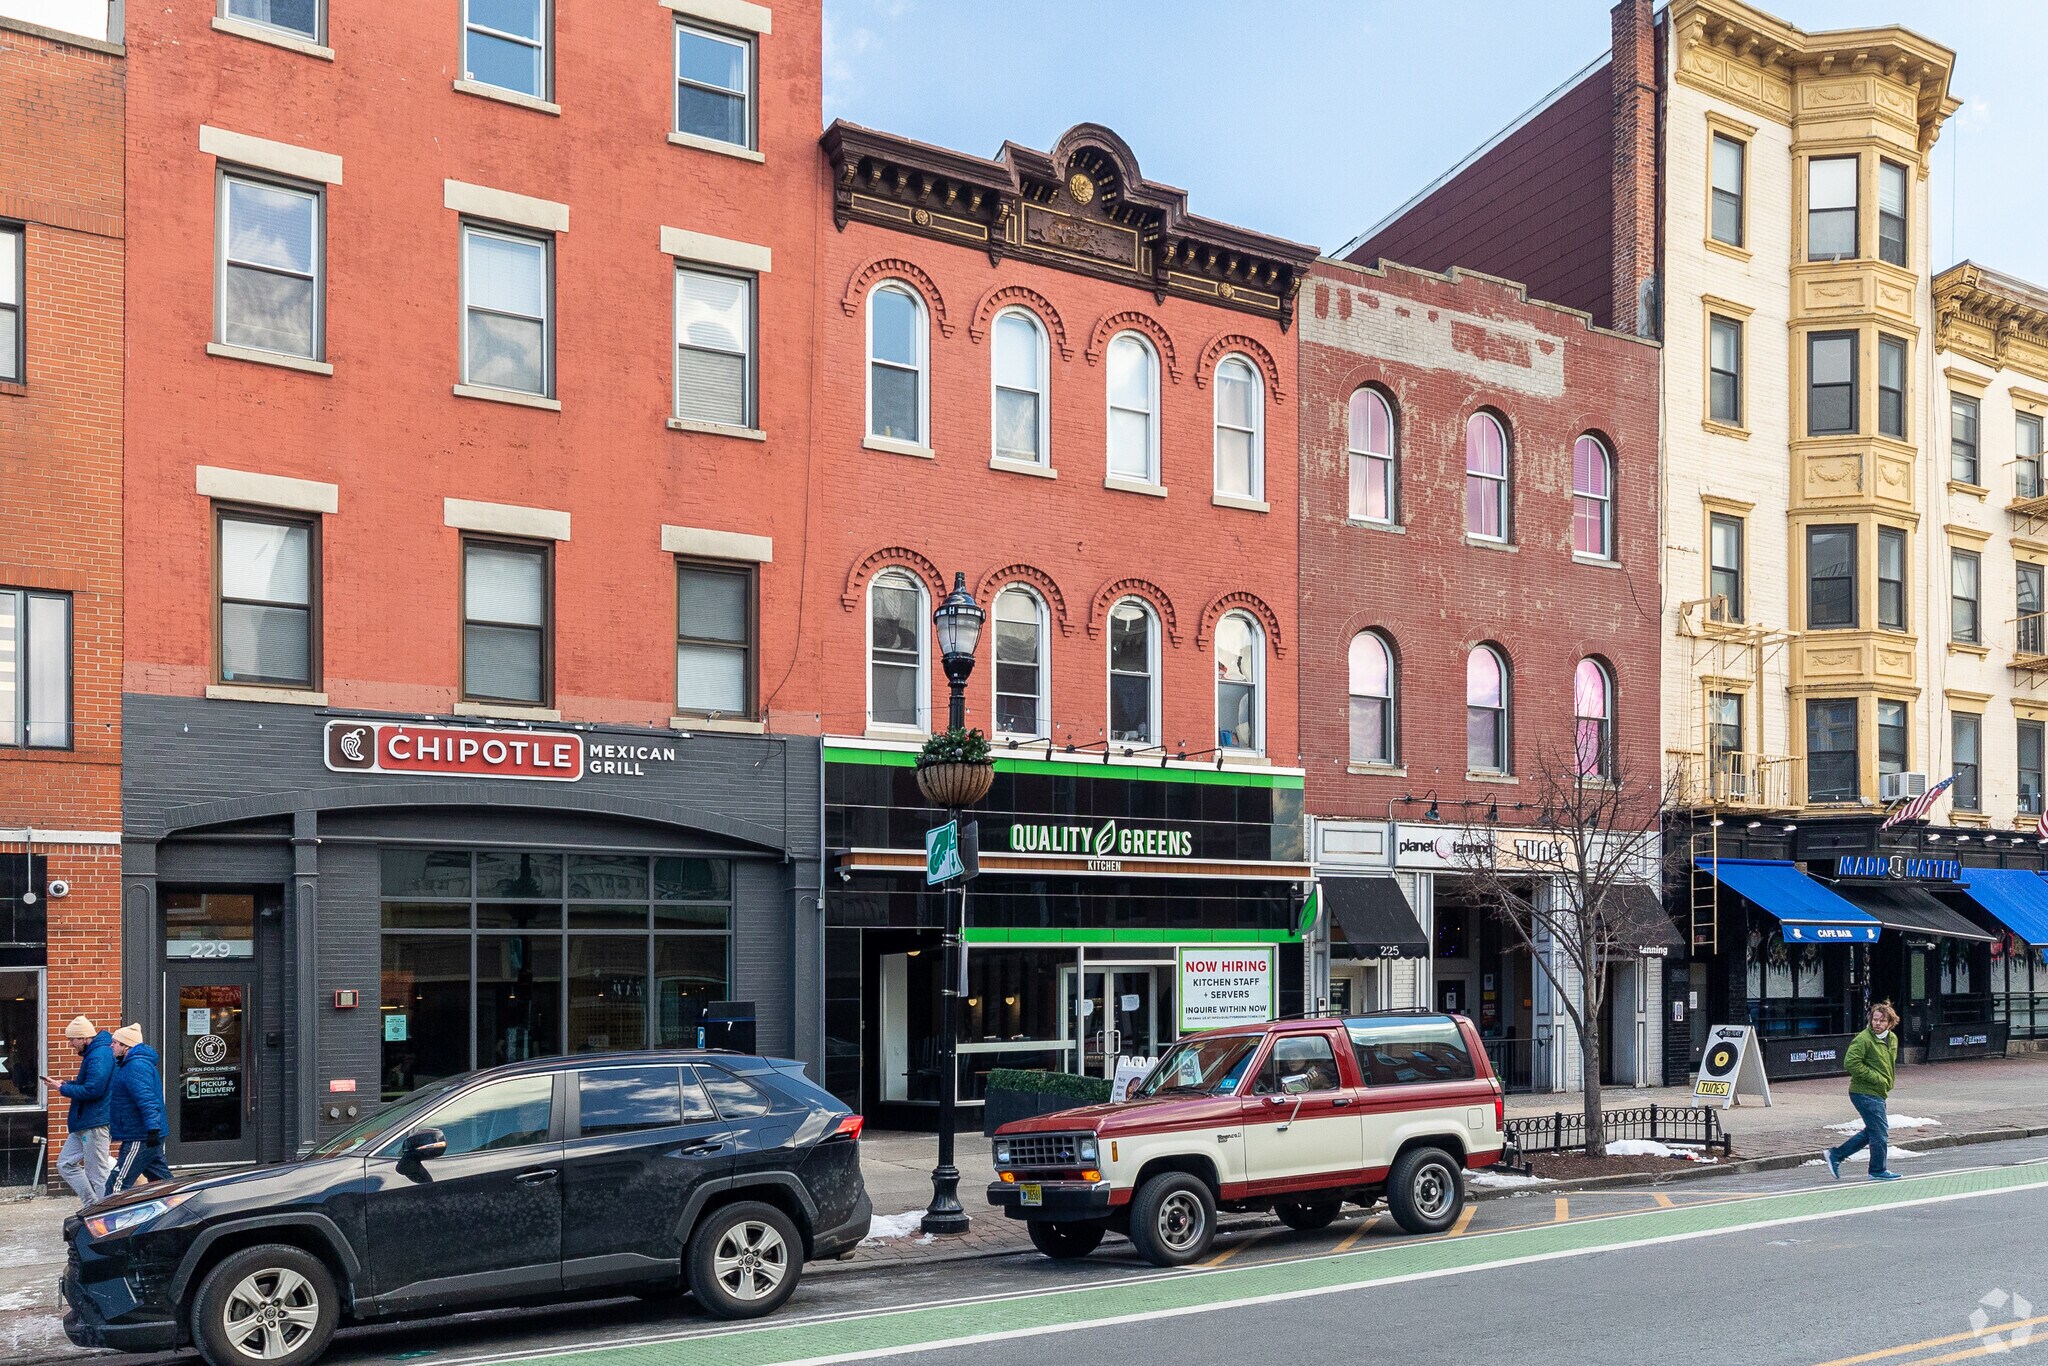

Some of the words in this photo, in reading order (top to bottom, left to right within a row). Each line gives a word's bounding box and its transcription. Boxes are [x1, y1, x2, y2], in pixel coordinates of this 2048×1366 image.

[388, 734, 572, 768] CHIPOTLE
[590, 744, 675, 761] MEXICAN
[590, 760, 645, 776] GRILL
[950, 824, 955, 844] 2
[1010, 824, 1093, 853] QUALITY
[1118, 829, 1192, 856] GREENS
[1400, 838, 1434, 854] planet
[1453, 841, 1492, 857] tanning
[1087, 860, 1121, 872] KITCHEN
[1838, 856, 1888, 876] MADD
[1905, 858, 1960, 878] HATTER
[1817, 929, 1837, 938] CAFE
[1837, 930, 1853, 938] BAR
[190, 942, 230, 958] 229
[1380, 945, 1400, 956] 225
[1639, 945, 1668, 956] tanning
[1186, 961, 1217, 973] NOW
[1222, 961, 1267, 972] HIRING
[1193, 978, 1231, 987] KITCHEN
[1233, 978, 1260, 986] STAFF
[1211, 990, 1250, 999] SERVERS
[1185, 1006, 1217, 1014] INQUIRE
[1219, 1005, 1247, 1013] WITHIN
[727, 1021, 733, 1032] 7
[197, 1036, 225, 1047] CHIPOTLE
[700, 1031, 704, 1044] P
[1701, 1082, 1726, 1094] TUNES
